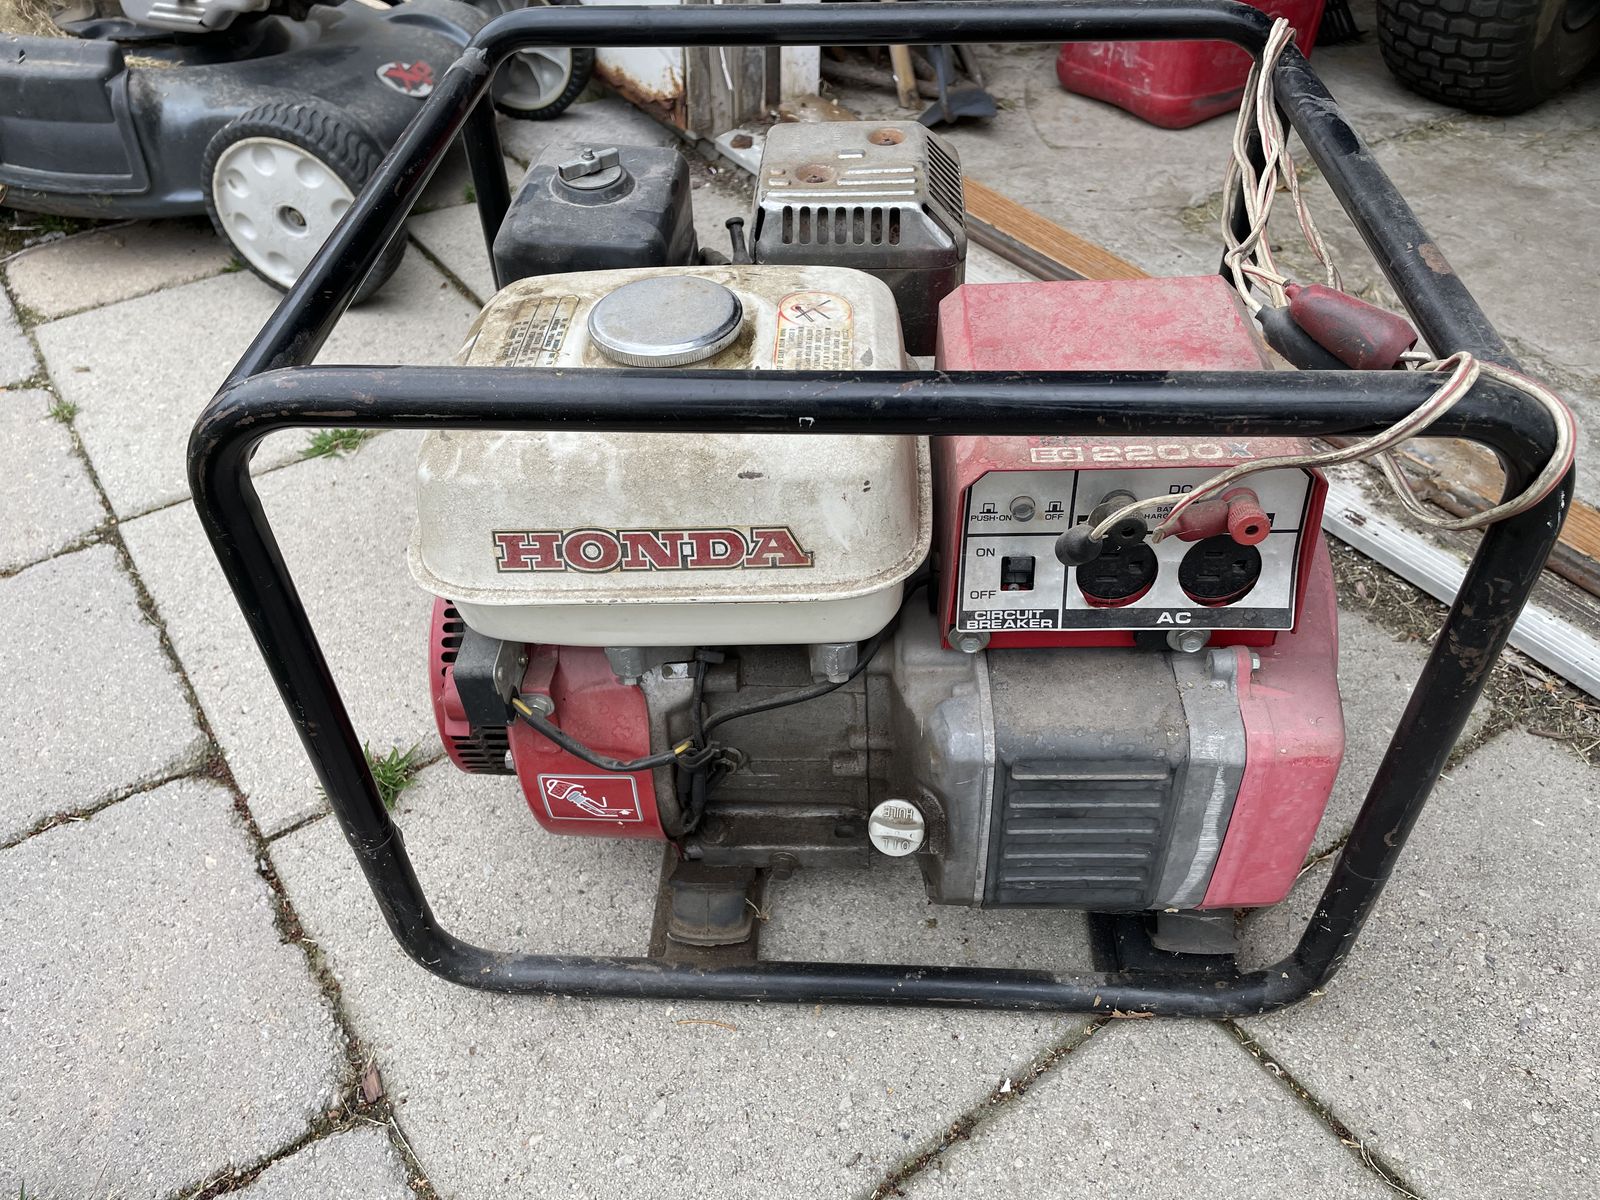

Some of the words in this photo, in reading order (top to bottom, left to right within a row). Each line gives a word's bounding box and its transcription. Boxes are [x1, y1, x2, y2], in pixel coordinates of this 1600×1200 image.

[1030, 447, 1084, 463] EG
[1169, 485, 1193, 495] DC
[1045, 513, 1064, 521] OFF
[492, 526, 815, 573] HONDA
[976, 548, 995, 557] ON
[970, 590, 997, 600] OFF
[974, 610, 1044, 620] CIRCUIT
[1156, 611, 1192, 625] AC
[966, 619, 1053, 630] BREAKER
[884, 805, 913, 819] HUILE
[882, 838, 910, 850] OIL
